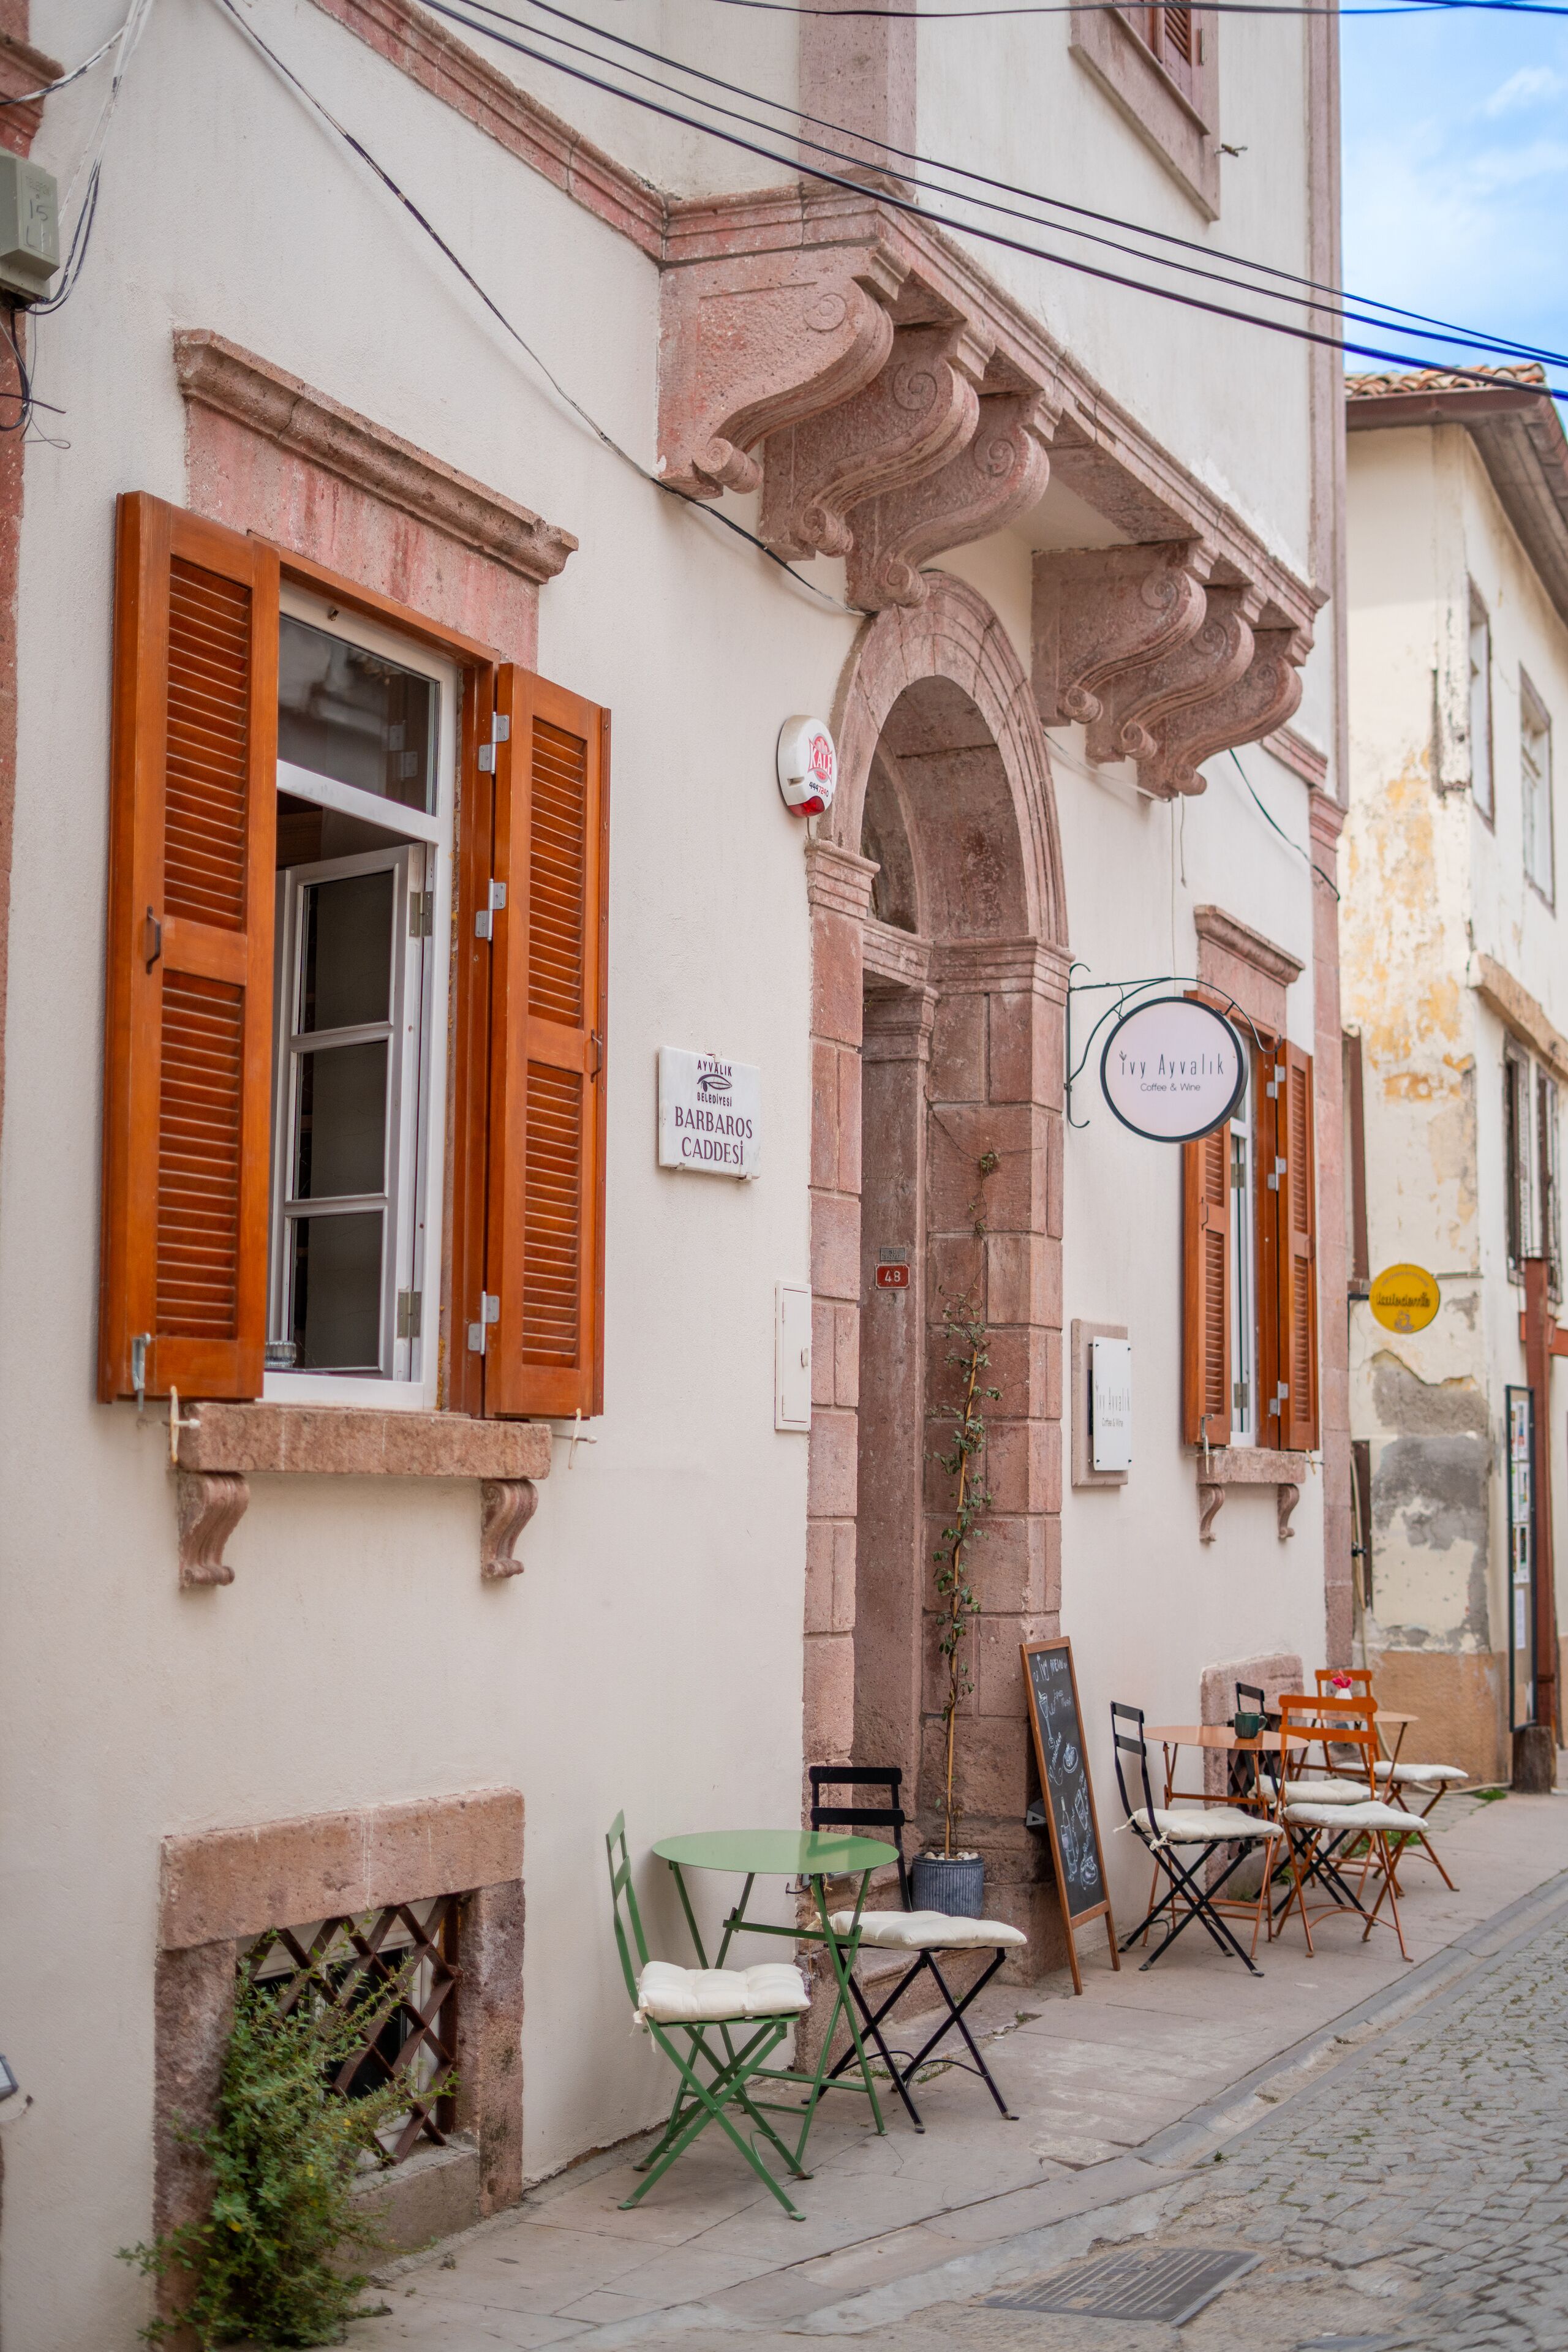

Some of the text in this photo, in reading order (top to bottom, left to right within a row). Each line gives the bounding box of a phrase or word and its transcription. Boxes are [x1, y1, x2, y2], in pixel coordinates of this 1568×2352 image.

[809, 742, 832, 780] KALE
[697, 1060, 733, 1077] AYVALIK
[1158, 1053, 1224, 1079] Ayvalık
[1140, 1083, 1201, 1091] Coffee & Wine
[697, 1091, 733, 1107] BELEDİYESİ
[674, 1106, 753, 1139] BARBAROS
[681, 1136, 744, 1165] CADDESİ
[884, 1270, 901, 1283] 48
